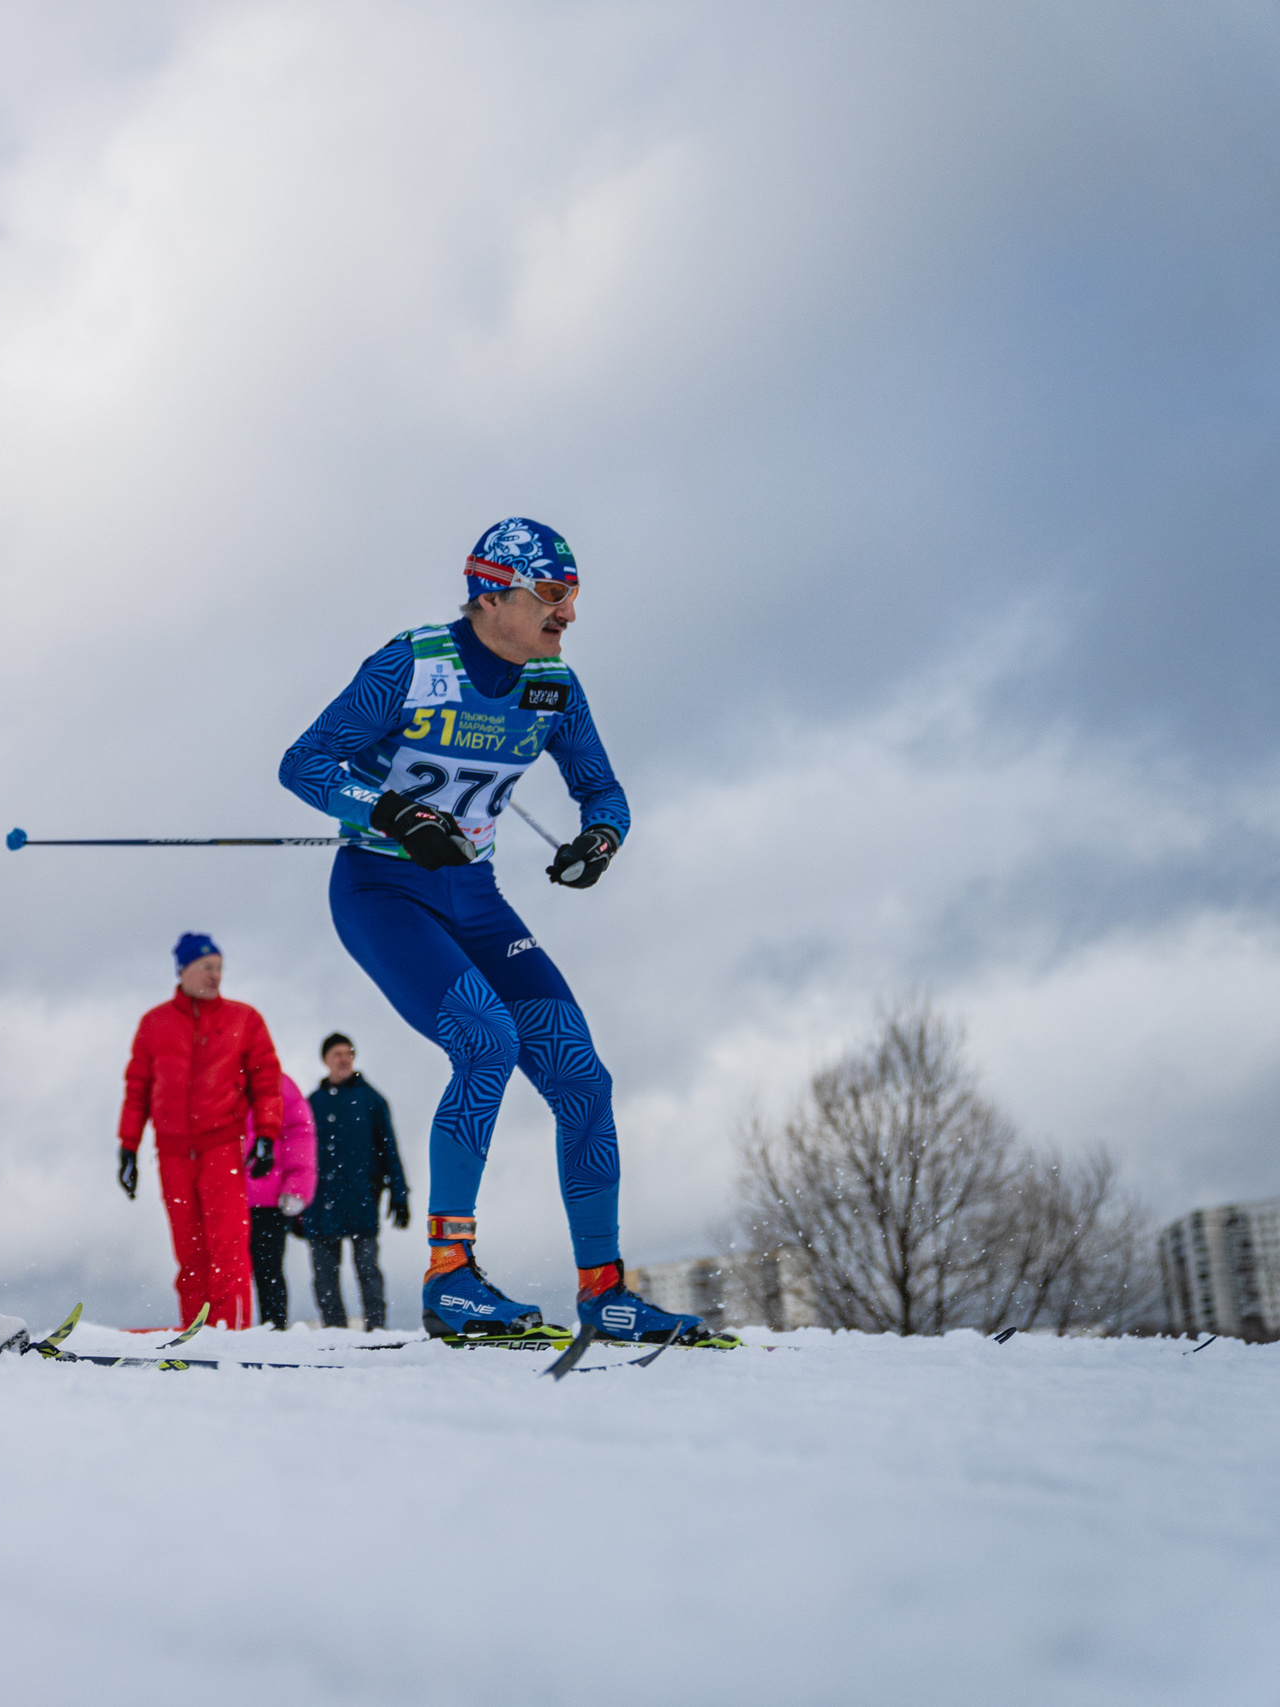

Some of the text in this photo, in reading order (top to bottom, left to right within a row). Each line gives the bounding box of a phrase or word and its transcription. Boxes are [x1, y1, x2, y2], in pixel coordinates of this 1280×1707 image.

[402, 707, 458, 747] 51
[458, 721, 506, 734] МАРАФОН
[460, 711, 506, 725] ЛЫЖНЫЙ
[454, 730, 507, 751] МВТУ
[440, 1294, 497, 1315] SPINE
